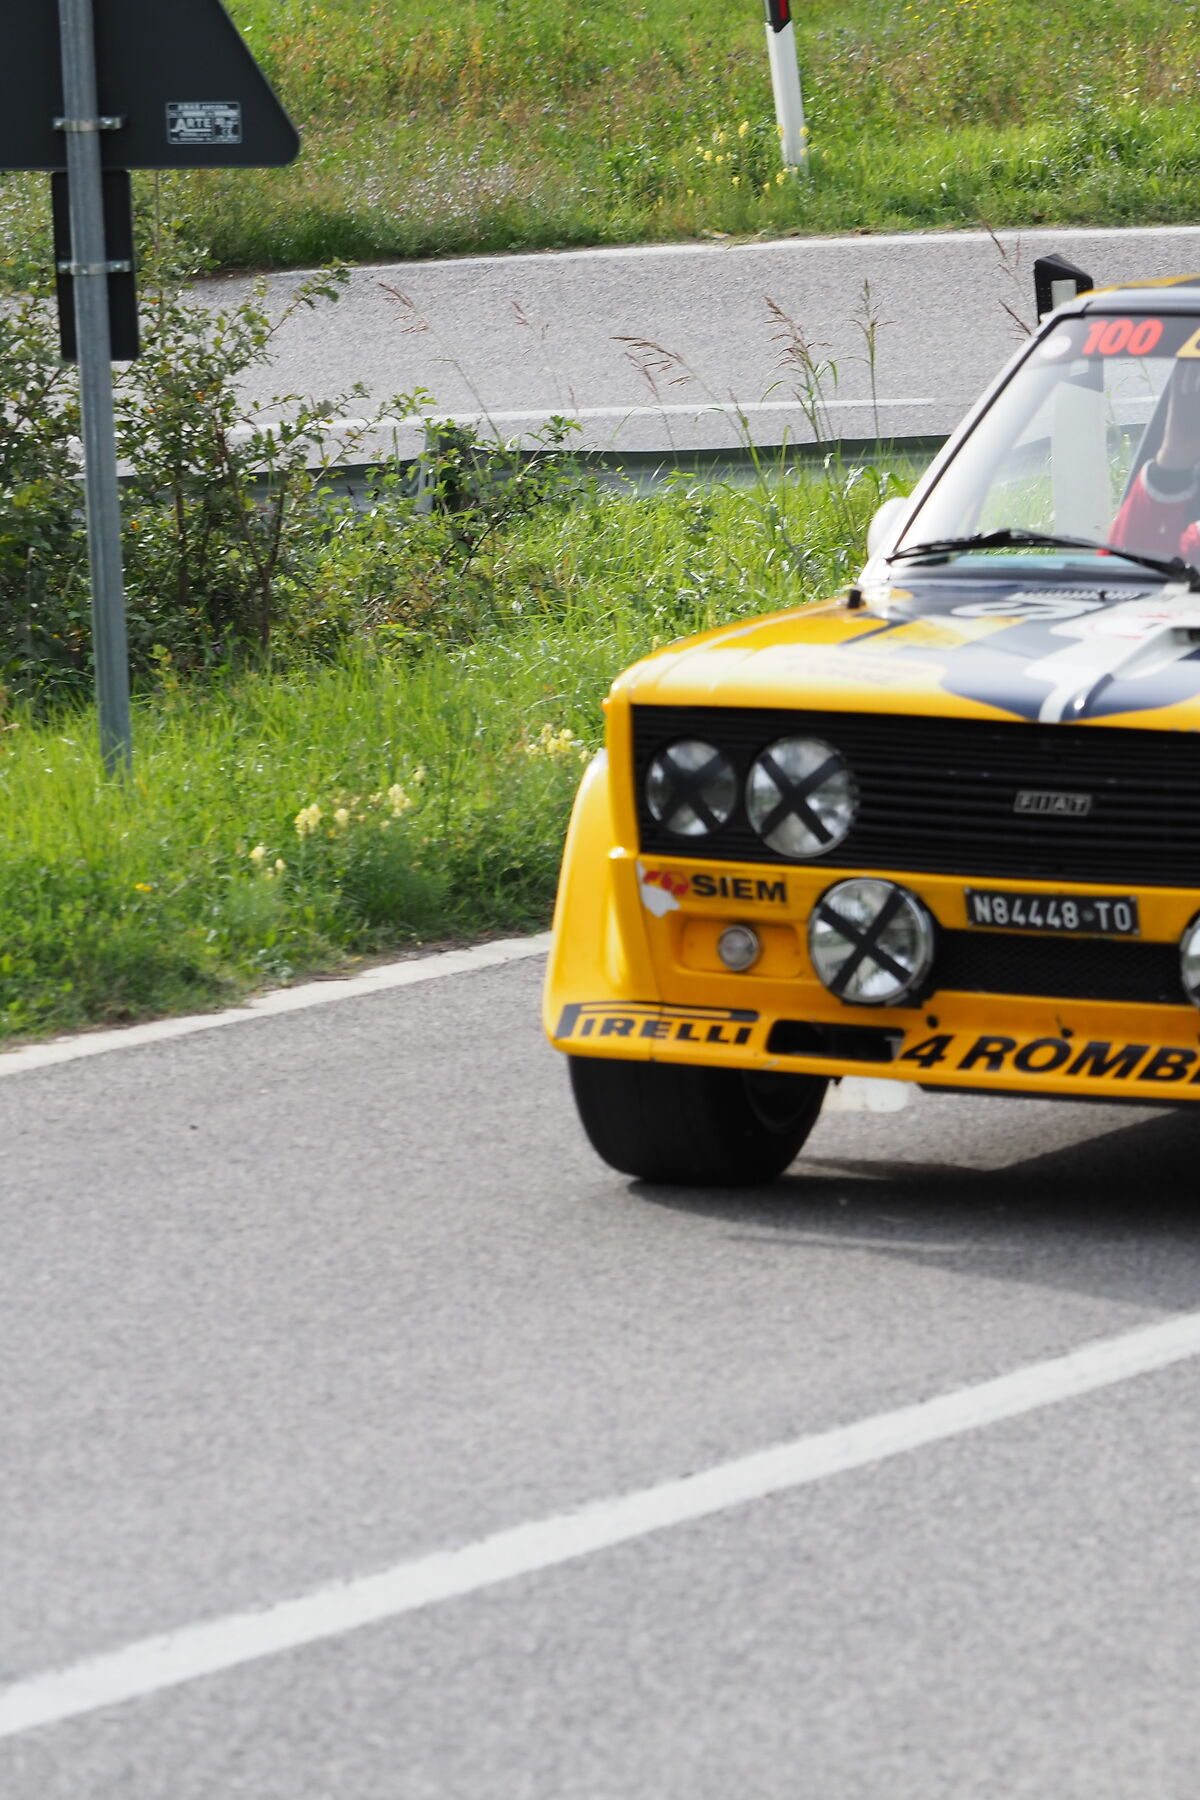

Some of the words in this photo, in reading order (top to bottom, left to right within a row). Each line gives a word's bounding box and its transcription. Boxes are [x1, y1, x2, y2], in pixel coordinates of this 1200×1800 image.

[1081, 319, 1164, 356] 100
[1018, 792, 1089, 814] FIAT
[691, 874, 787, 903] SIEM
[973, 895, 1080, 929] N84448
[1093, 902, 1132, 931] TO
[555, 1001, 760, 1046] PIRELLI
[901, 1034, 955, 1069] 4
